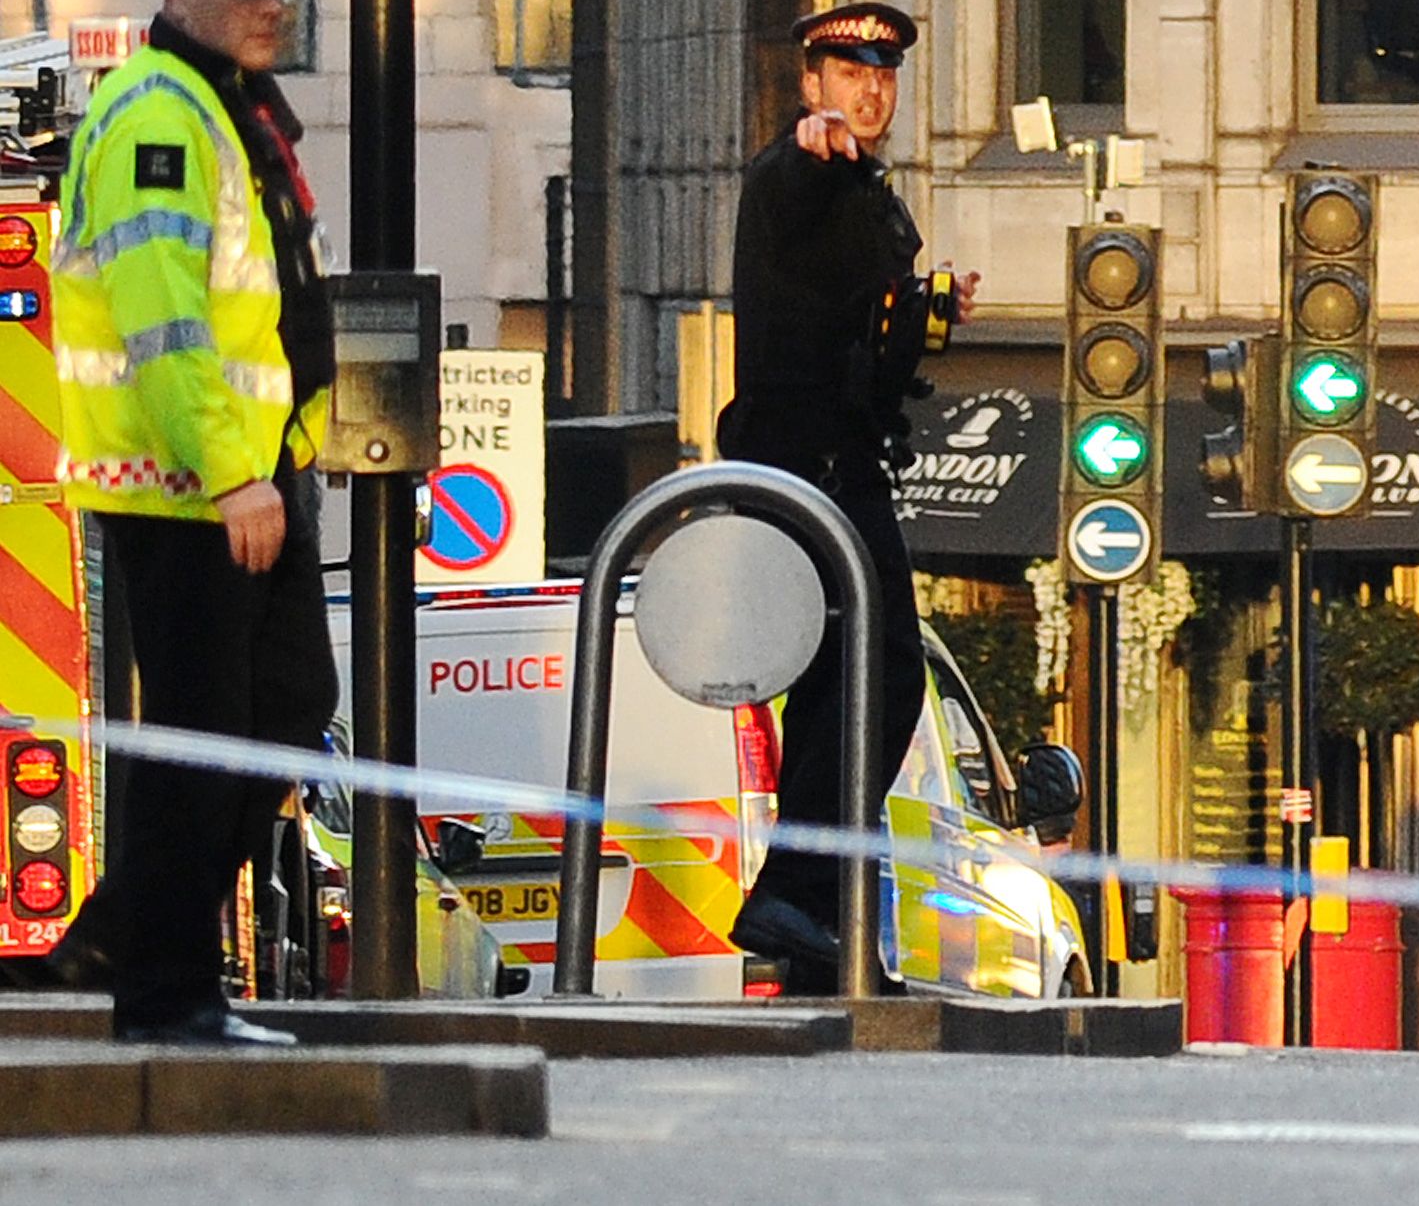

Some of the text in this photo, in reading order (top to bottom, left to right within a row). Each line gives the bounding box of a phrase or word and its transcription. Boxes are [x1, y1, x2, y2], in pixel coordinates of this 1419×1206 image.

[442, 363, 533, 385] tricted
[444, 394, 511, 418] rking
[439, 424, 511, 451] ONE
[898, 452, 1027, 487] ONDON
[430, 654, 564, 695] POLICE
